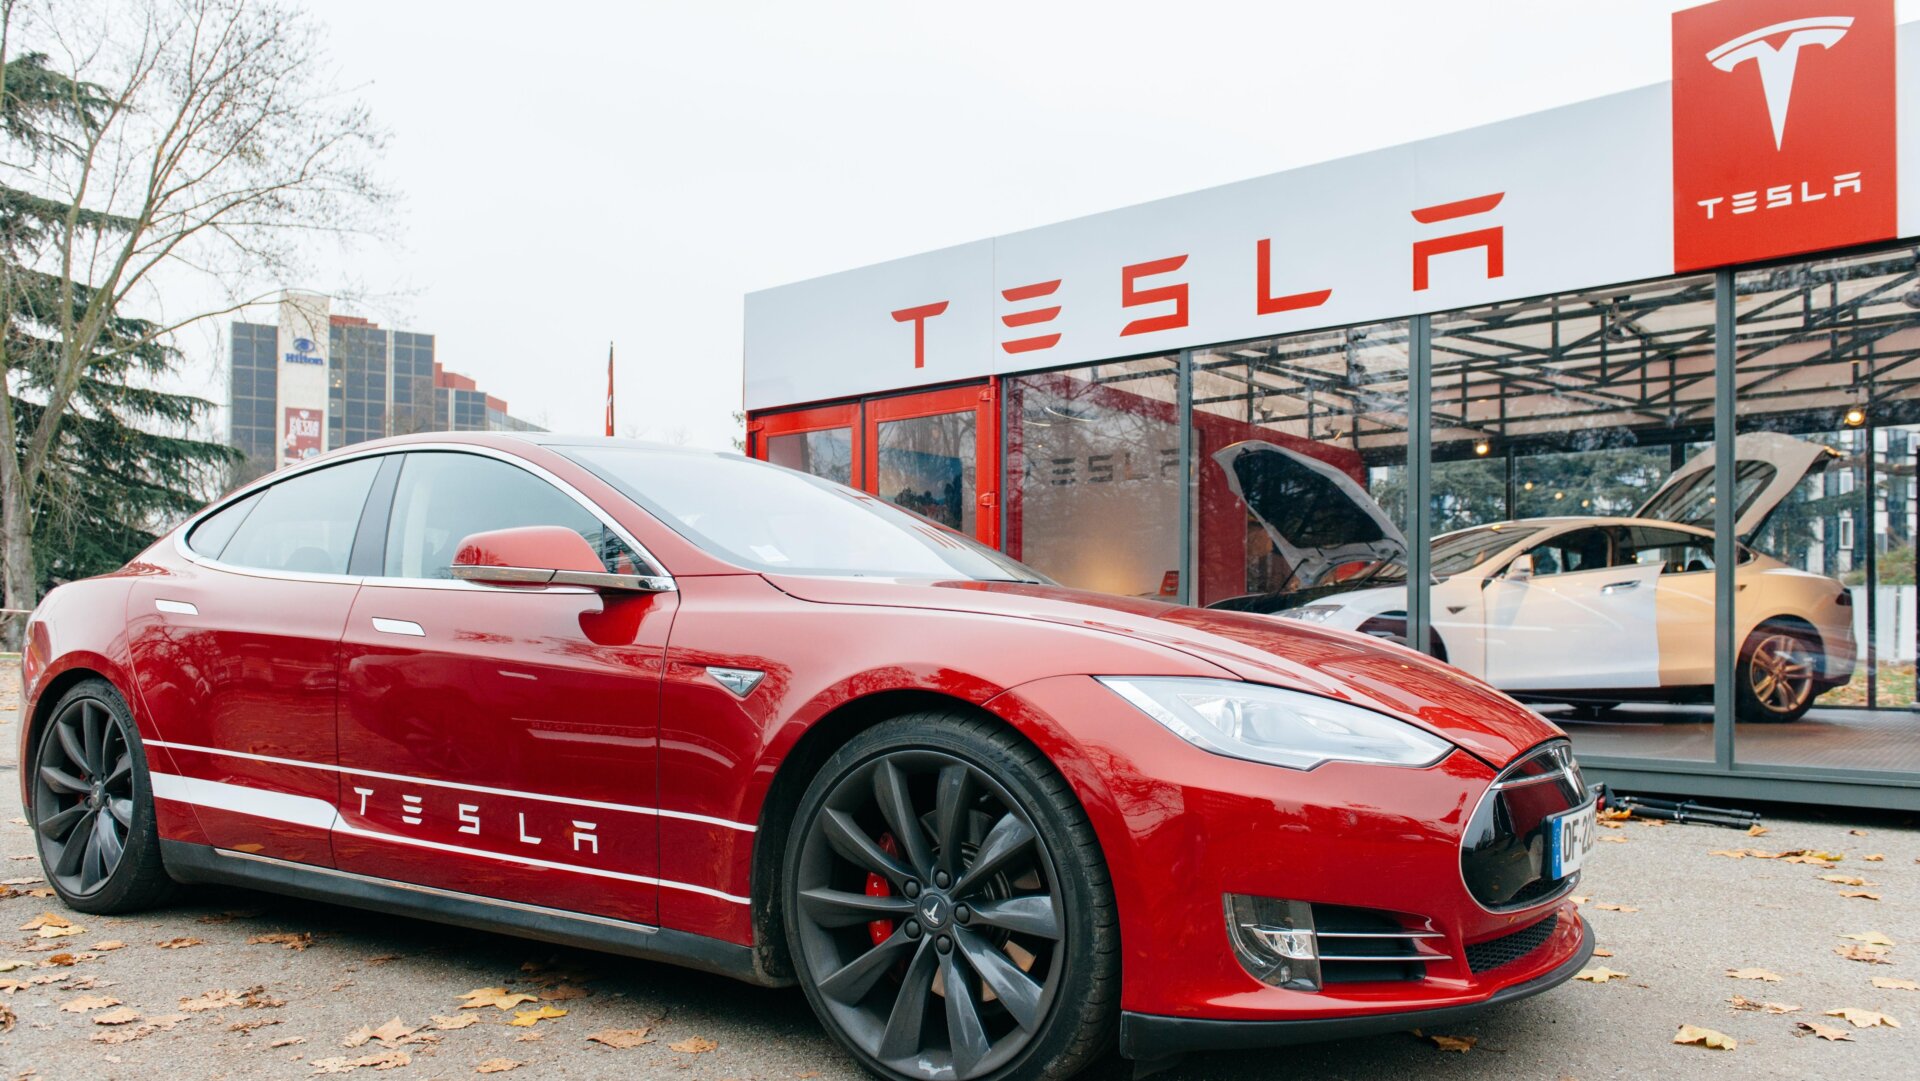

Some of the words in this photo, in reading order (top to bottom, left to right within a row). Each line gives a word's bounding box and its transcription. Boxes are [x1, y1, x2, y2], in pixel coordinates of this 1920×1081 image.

[1697, 171, 1861, 219] TESLA
[890, 191, 1505, 368] TESLA
[285, 352, 324, 366] Hilton
[1025, 448, 1180, 486] ESLA
[353, 787, 598, 854] TESLA
